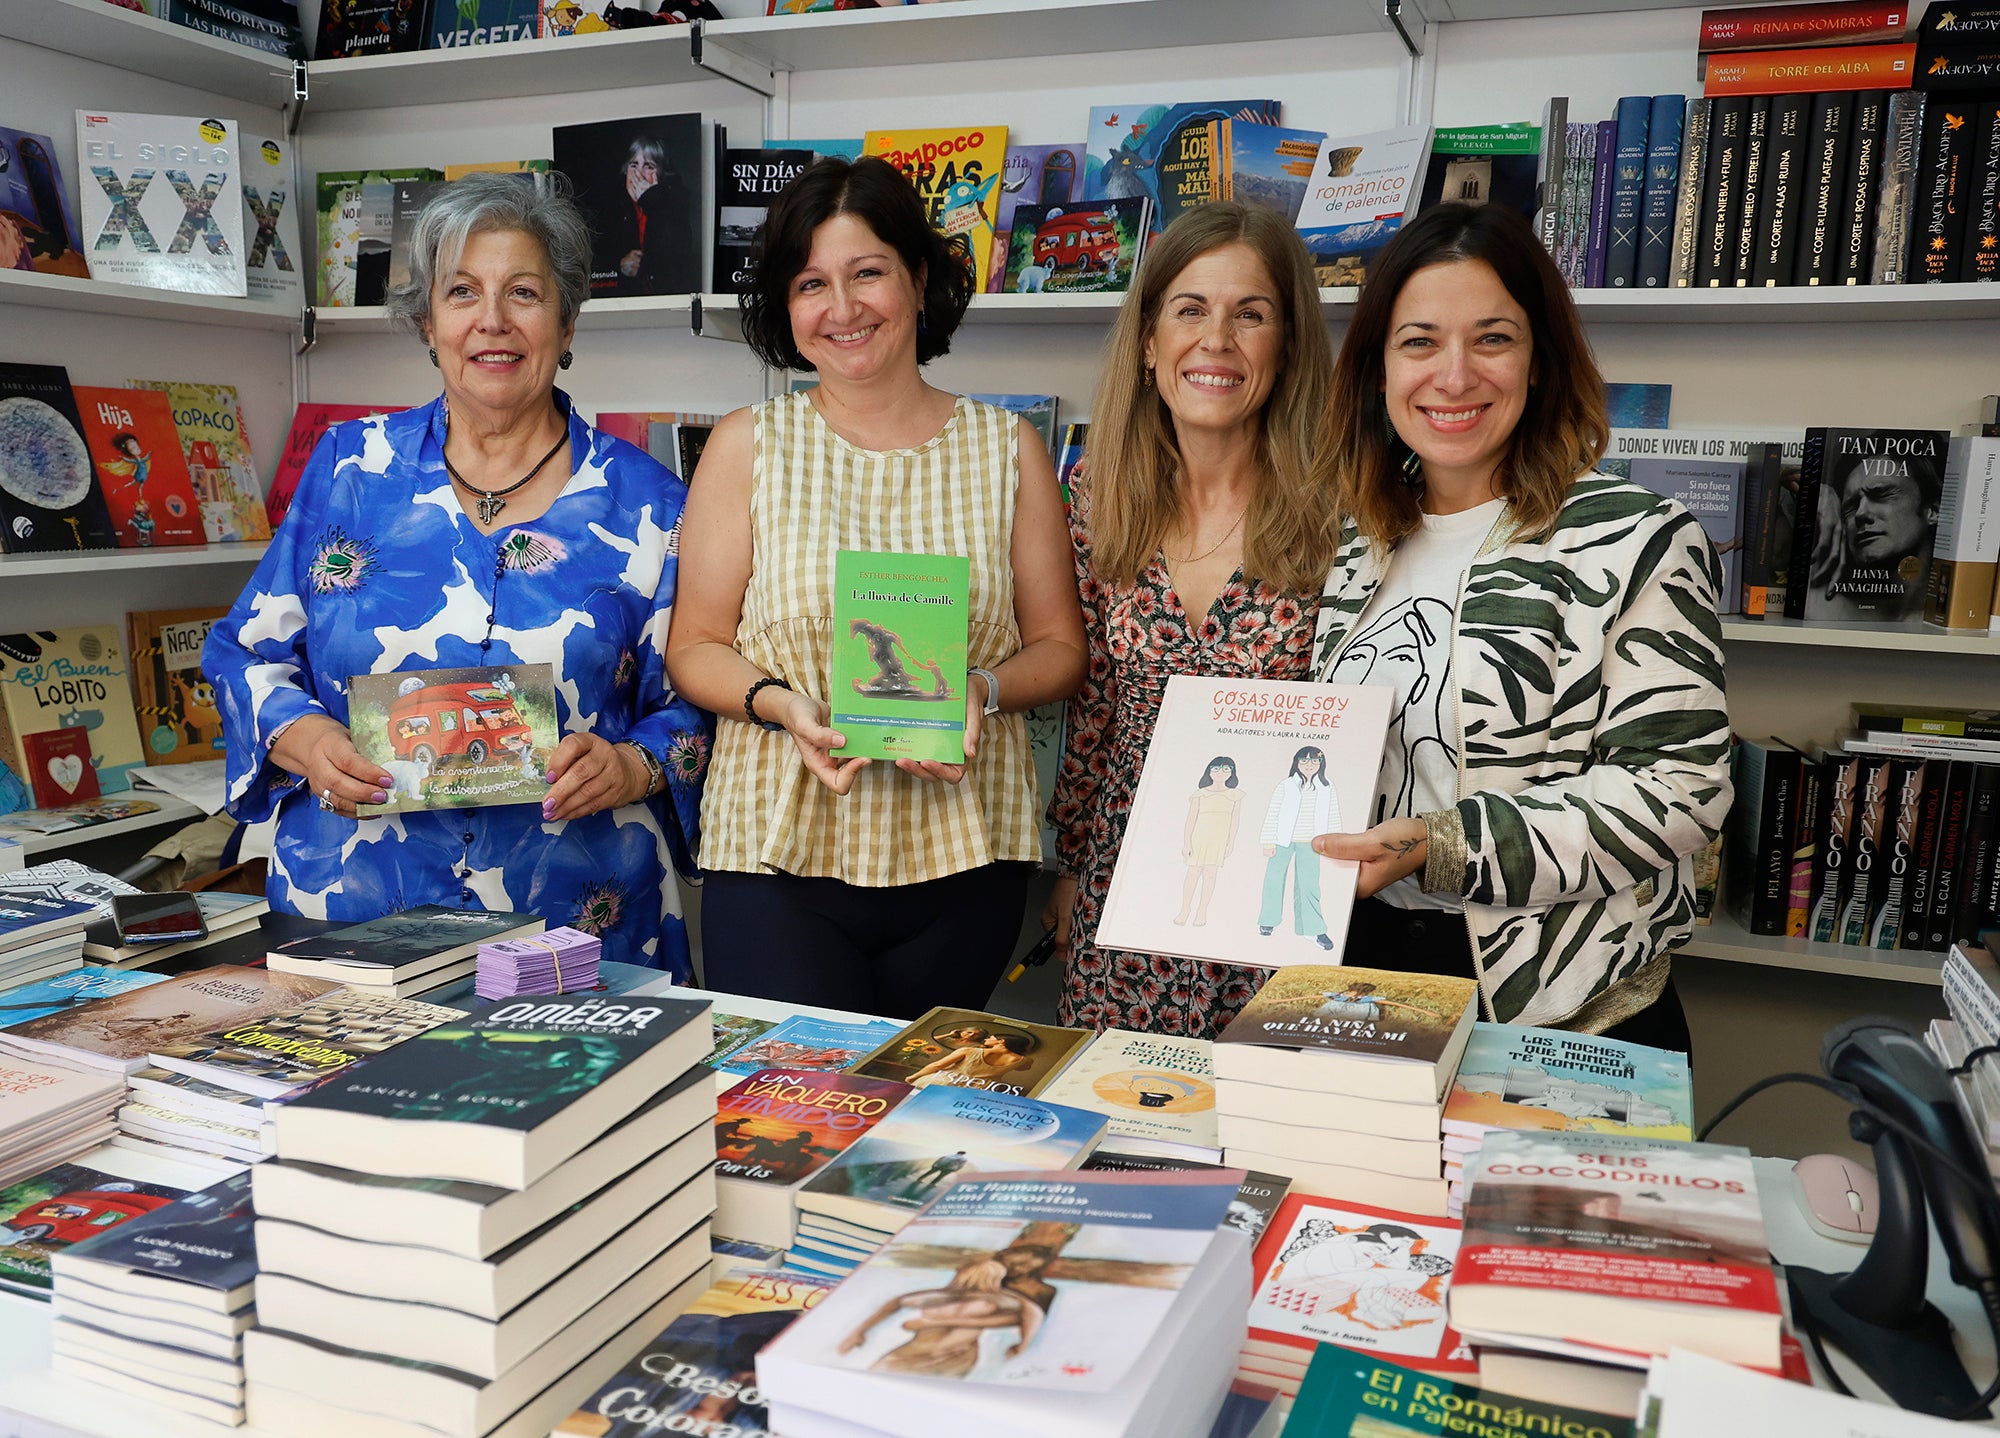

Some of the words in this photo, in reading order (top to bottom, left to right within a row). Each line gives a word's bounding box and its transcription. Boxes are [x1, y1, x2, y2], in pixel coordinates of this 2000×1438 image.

[200, 0, 266, 31] MEMORIA
[268, 24, 289, 37] DE
[1708, 23, 1734, 32] SARAH
[1752, 22, 1790, 35] REINA
[1793, 22, 1805, 30] DE
[1808, 16, 1873, 30] SOMBRAS
[185, 13, 209, 32] LAS
[211, 25, 288, 53] PRADERAS
[345, 32, 390, 51] planeta
[1713, 30, 1735, 38] MAAS
[1714, 67, 1740, 76] SARAH
[1718, 74, 1742, 83] MAAS
[1768, 65, 1810, 78] TORRE
[1814, 65, 1833, 74] DEL
[1837, 62, 1870, 74] ALBA
[1453, 141, 1495, 150] PALENCIA
[1457, 133, 1479, 141] Iglesia
[1490, 133, 1504, 141] San
[1505, 132, 1529, 142] Miguel
[86, 141, 124, 161] EL
[138, 143, 231, 167] SIGLO
[1722, 147, 1733, 175] FURIA
[1779, 149, 1791, 179] RUINA
[1822, 138, 1836, 184] PLATEADAS
[732, 164, 759, 178] SIN
[764, 160, 805, 178] DÍAS
[1184, 161, 1201, 170] HAY
[738, 179, 757, 193] NI
[1316, 175, 1406, 201] románico
[1717, 180, 1730, 213] NIEBLA
[1932, 173, 1949, 199] BIRD
[1326, 200, 1343, 212] de
[1344, 192, 1402, 213] palencia
[1775, 185, 1787, 209] ALAS
[1817, 184, 1830, 217] LLAMAS
[90, 165, 235, 257] XX
[1718, 213, 1726, 222] DE
[1776, 208, 1783, 218] DE
[1818, 216, 1826, 225] DE
[1928, 200, 1945, 234] BLACK
[1713, 221, 1726, 252] CORTE
[1770, 218, 1783, 248] CORTE
[1813, 222, 1826, 254] CORTE
[1713, 253, 1721, 267] UNA
[1770, 250, 1778, 264] UNA
[1812, 254, 1820, 269] UNA
[1925, 253, 1948, 263] STELLA
[97, 402, 134, 430] Hija
[172, 408, 235, 427] COPACO
[1618, 437, 1658, 455] DONDE
[1662, 438, 1699, 455] VIVEN
[1702, 440, 1725, 457] LOS
[1838, 436, 1880, 456] TAN
[1884, 437, 1938, 458] POCA
[1861, 458, 1911, 479] VIDA
[1984, 452, 1995, 476] Hanya
[1674, 492, 1688, 502] por
[1689, 491, 1702, 501] las
[1702, 490, 1730, 502] sílabas
[1689, 480, 1697, 491] Si
[1698, 482, 1709, 491] no
[1709, 480, 1731, 492] fuera
[1979, 476, 1994, 515] Yanagihara
[1686, 501, 1699, 511] del
[1700, 501, 1730, 512] sábado
[859, 571, 891, 580] ESTHER
[892, 572, 949, 583] BENGOECHEA
[1852, 568, 1891, 582] HANYA
[852, 589, 866, 600] La
[868, 590, 898, 602] lluvia
[899, 592, 912, 603] de
[914, 593, 955, 605] Camille
[1833, 582, 1906, 596] YANAGIHARA
[17, 663, 49, 688] El
[54, 657, 114, 678] Buen
[34, 679, 107, 709] LOBITO
[1213, 690, 1270, 707] COSAS
[1273, 693, 1308, 710] QUE
[1312, 696, 1349, 712] SOY
[1213, 707, 1224, 721] Y
[1227, 707, 1296, 726] SIEMPRE
[1299, 712, 1341, 729] SERÉ
[431, 765, 445, 776] La
[448, 765, 500, 776] aventura
[501, 761, 515, 773] de
[429, 781, 441, 793] la
[443, 780, 521, 795] autocaravana
[1777, 779, 1788, 802] Chica
[1775, 803, 1786, 821] Soto
[1927, 789, 1941, 820] MOLA
[1951, 790, 1964, 821] MOLA
[1826, 765, 1850, 868] FRANCO
[1855, 767, 1881, 871] FRANCO
[1774, 822, 1785, 840] José
[1919, 821, 1936, 868] CARMEN
[1943, 822, 1959, 869] CARMEN
[1767, 850, 1782, 899] PELAYO
[1914, 869, 1928, 898] CLAN
[1938, 871, 1952, 901] CLAN
[1912, 899, 1922, 913] EL
[1936, 901, 1946, 915] EL
[181, 982, 261, 1004] Posguerra
[203, 978, 244, 992] Baile
[244, 986, 265, 997] de
[488, 1003, 663, 1030] OMEGA
[1300, 1016, 1323, 1026] LA
[1329, 1018, 1376, 1031] NIÑA
[543, 1023, 640, 1038] AURORA
[1262, 1022, 1302, 1031] QUE
[1303, 1024, 1346, 1035] HAY
[1350, 1029, 1377, 1039] EN
[1382, 1031, 1408, 1042] MÍ
[1124, 1045, 1213, 1065] escritor
[1130, 1040, 1158, 1050] Me
[1163, 1044, 1201, 1056] hice
[1521, 1035, 1554, 1047] LAS
[1561, 1040, 1627, 1059] NOCHES
[1524, 1045, 1557, 1057] QUE
[1564, 1051, 1621, 1068] NUNCA
[1121, 1050, 1183, 1065] porque
[1188, 1060, 1209, 1068] no
[1508, 1051, 1534, 1063] TE
[1541, 1057, 1635, 1080] CONTARON
[759, 1073, 804, 1085] UN
[346, 1083, 418, 1100] DANIEL
[457, 1094, 530, 1109] BORGE
[743, 1081, 888, 1117] VAQUERO
[724, 1094, 865, 1131] TÍMIDO
[952, 1100, 1055, 1126] BUSCANDO
[955, 1110, 1037, 1131] ECLIPSES
[1145, 1122, 1193, 1134] RELATOS
[1576, 1152, 1649, 1169] SEIS
[957, 1183, 980, 1192] Te
[983, 1182, 1077, 1194] llamarán
[1487, 1164, 1747, 1195] COCODRILOS
[735, 1275, 804, 1305] TESS
[1369, 1367, 1403, 1395] El
[1413, 1381, 1611, 1438] Románico
[1362, 1391, 1399, 1412] en
[1407, 1401, 1529, 1438] Palencia
